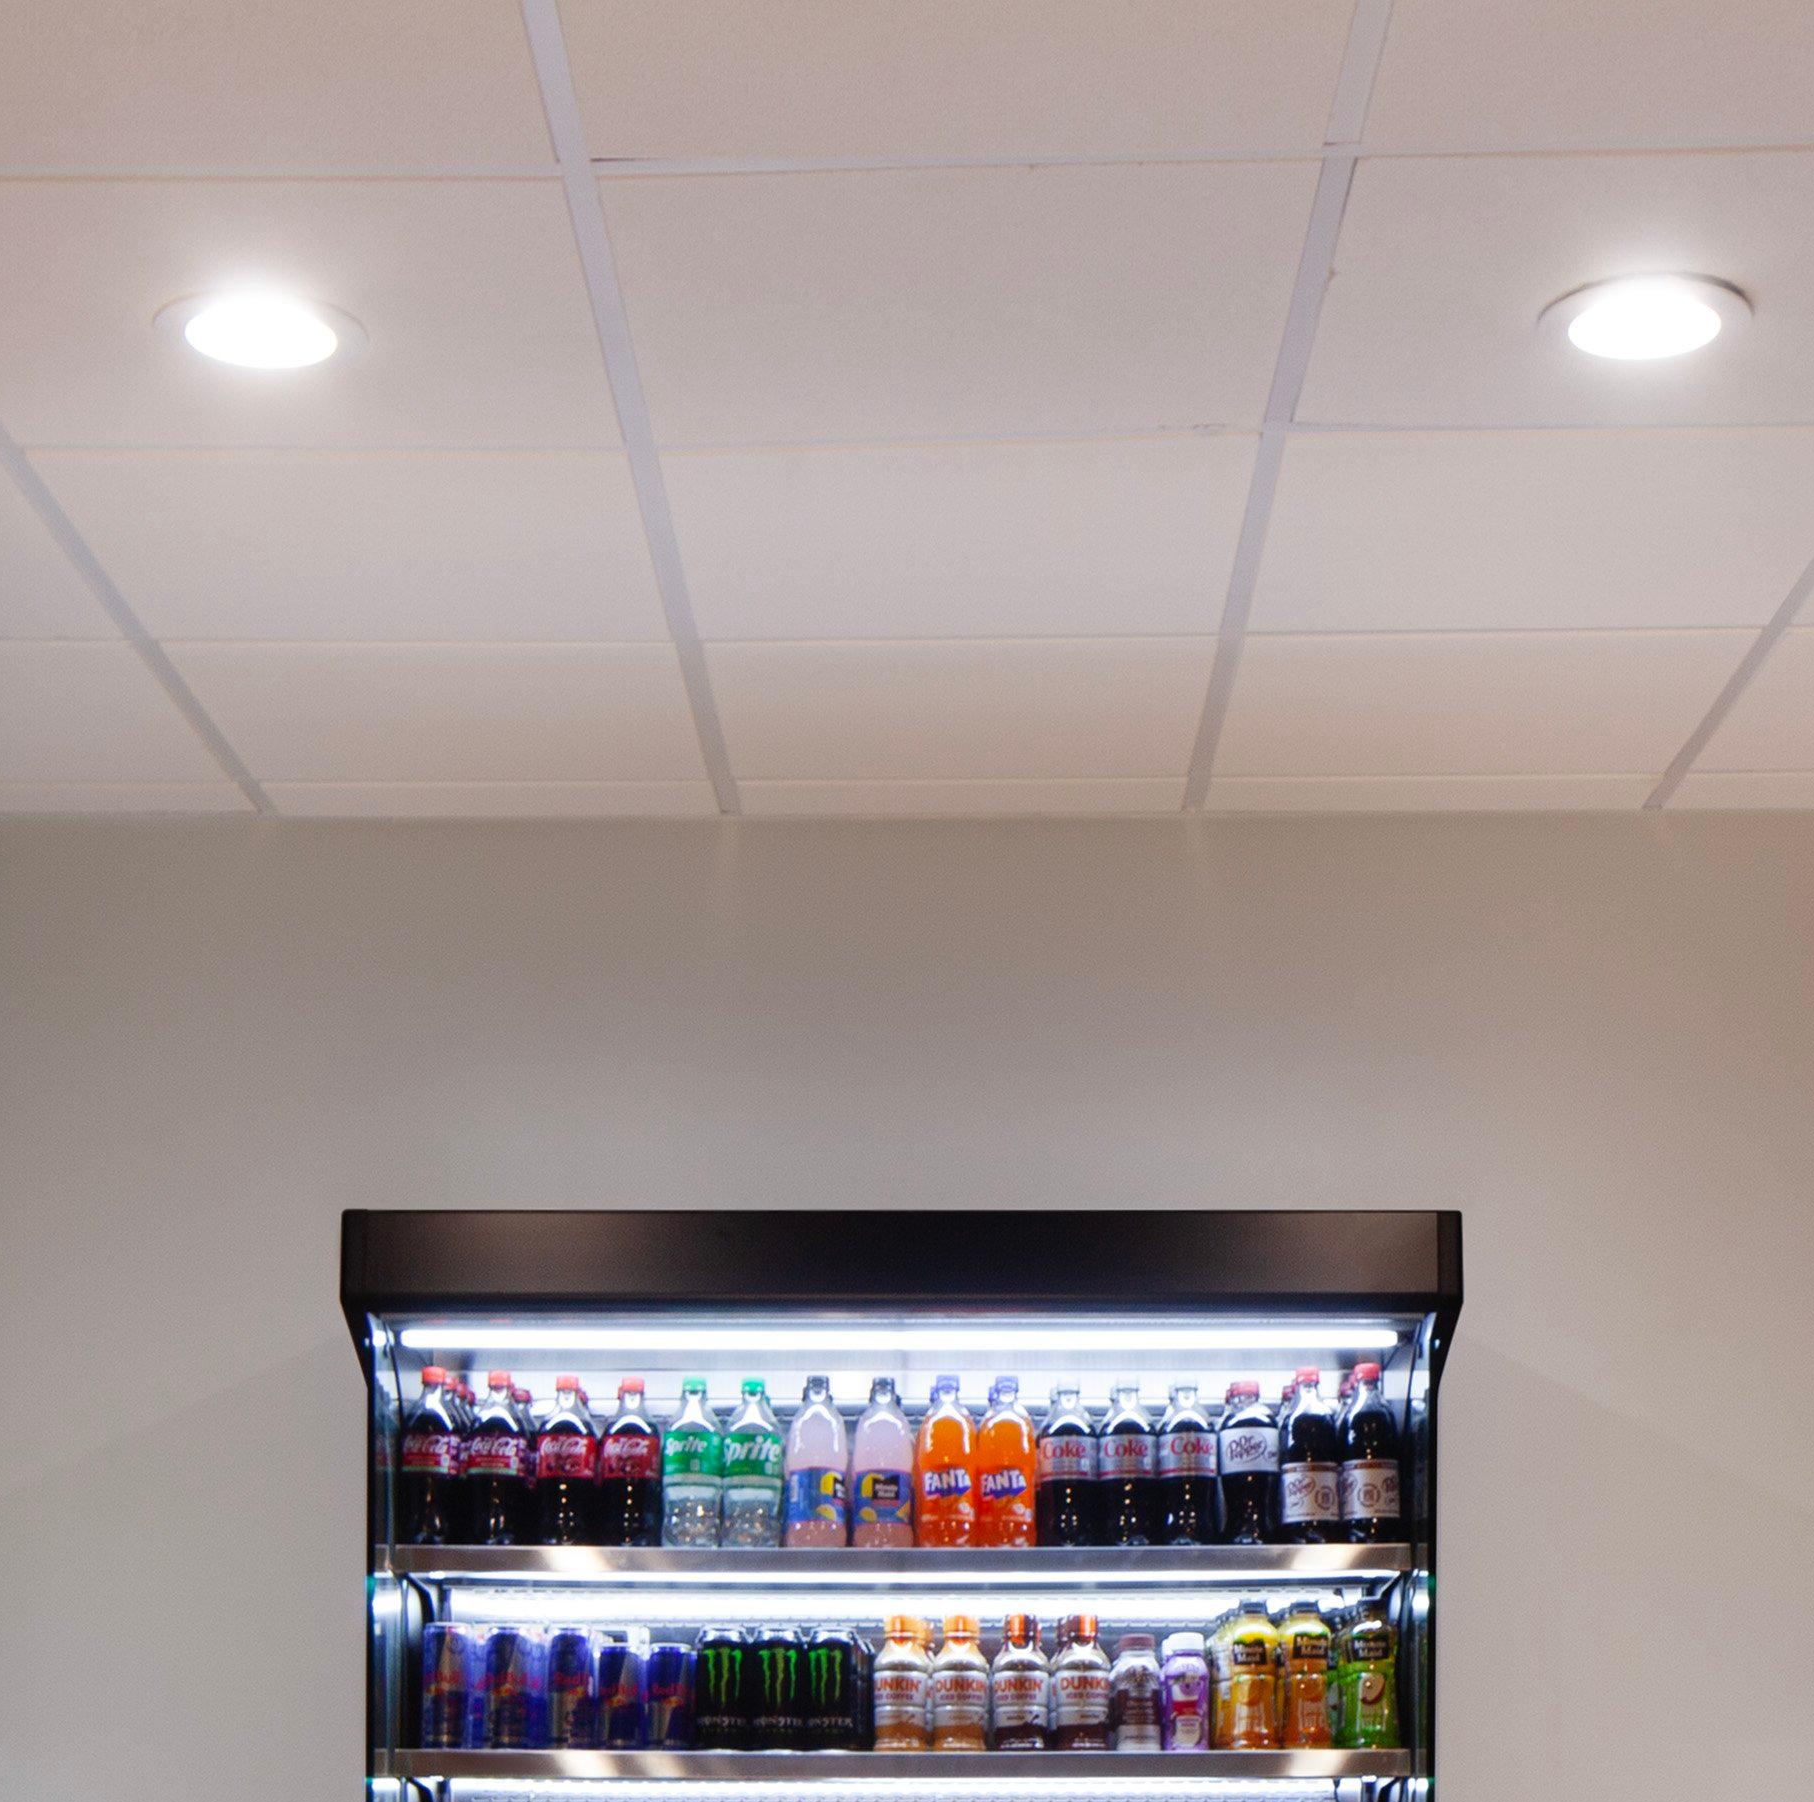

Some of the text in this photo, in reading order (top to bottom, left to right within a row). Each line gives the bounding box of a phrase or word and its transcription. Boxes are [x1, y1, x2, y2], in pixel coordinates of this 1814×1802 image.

[665, 1437, 708, 1457] Sprite
[724, 1437, 783, 1463] Sprite
[1043, 1440, 1086, 1458] Coke
[1104, 1440, 1148, 1458] Coke
[1170, 1439, 1214, 1458] Coke
[980, 1471, 1027, 1494] FANTA
